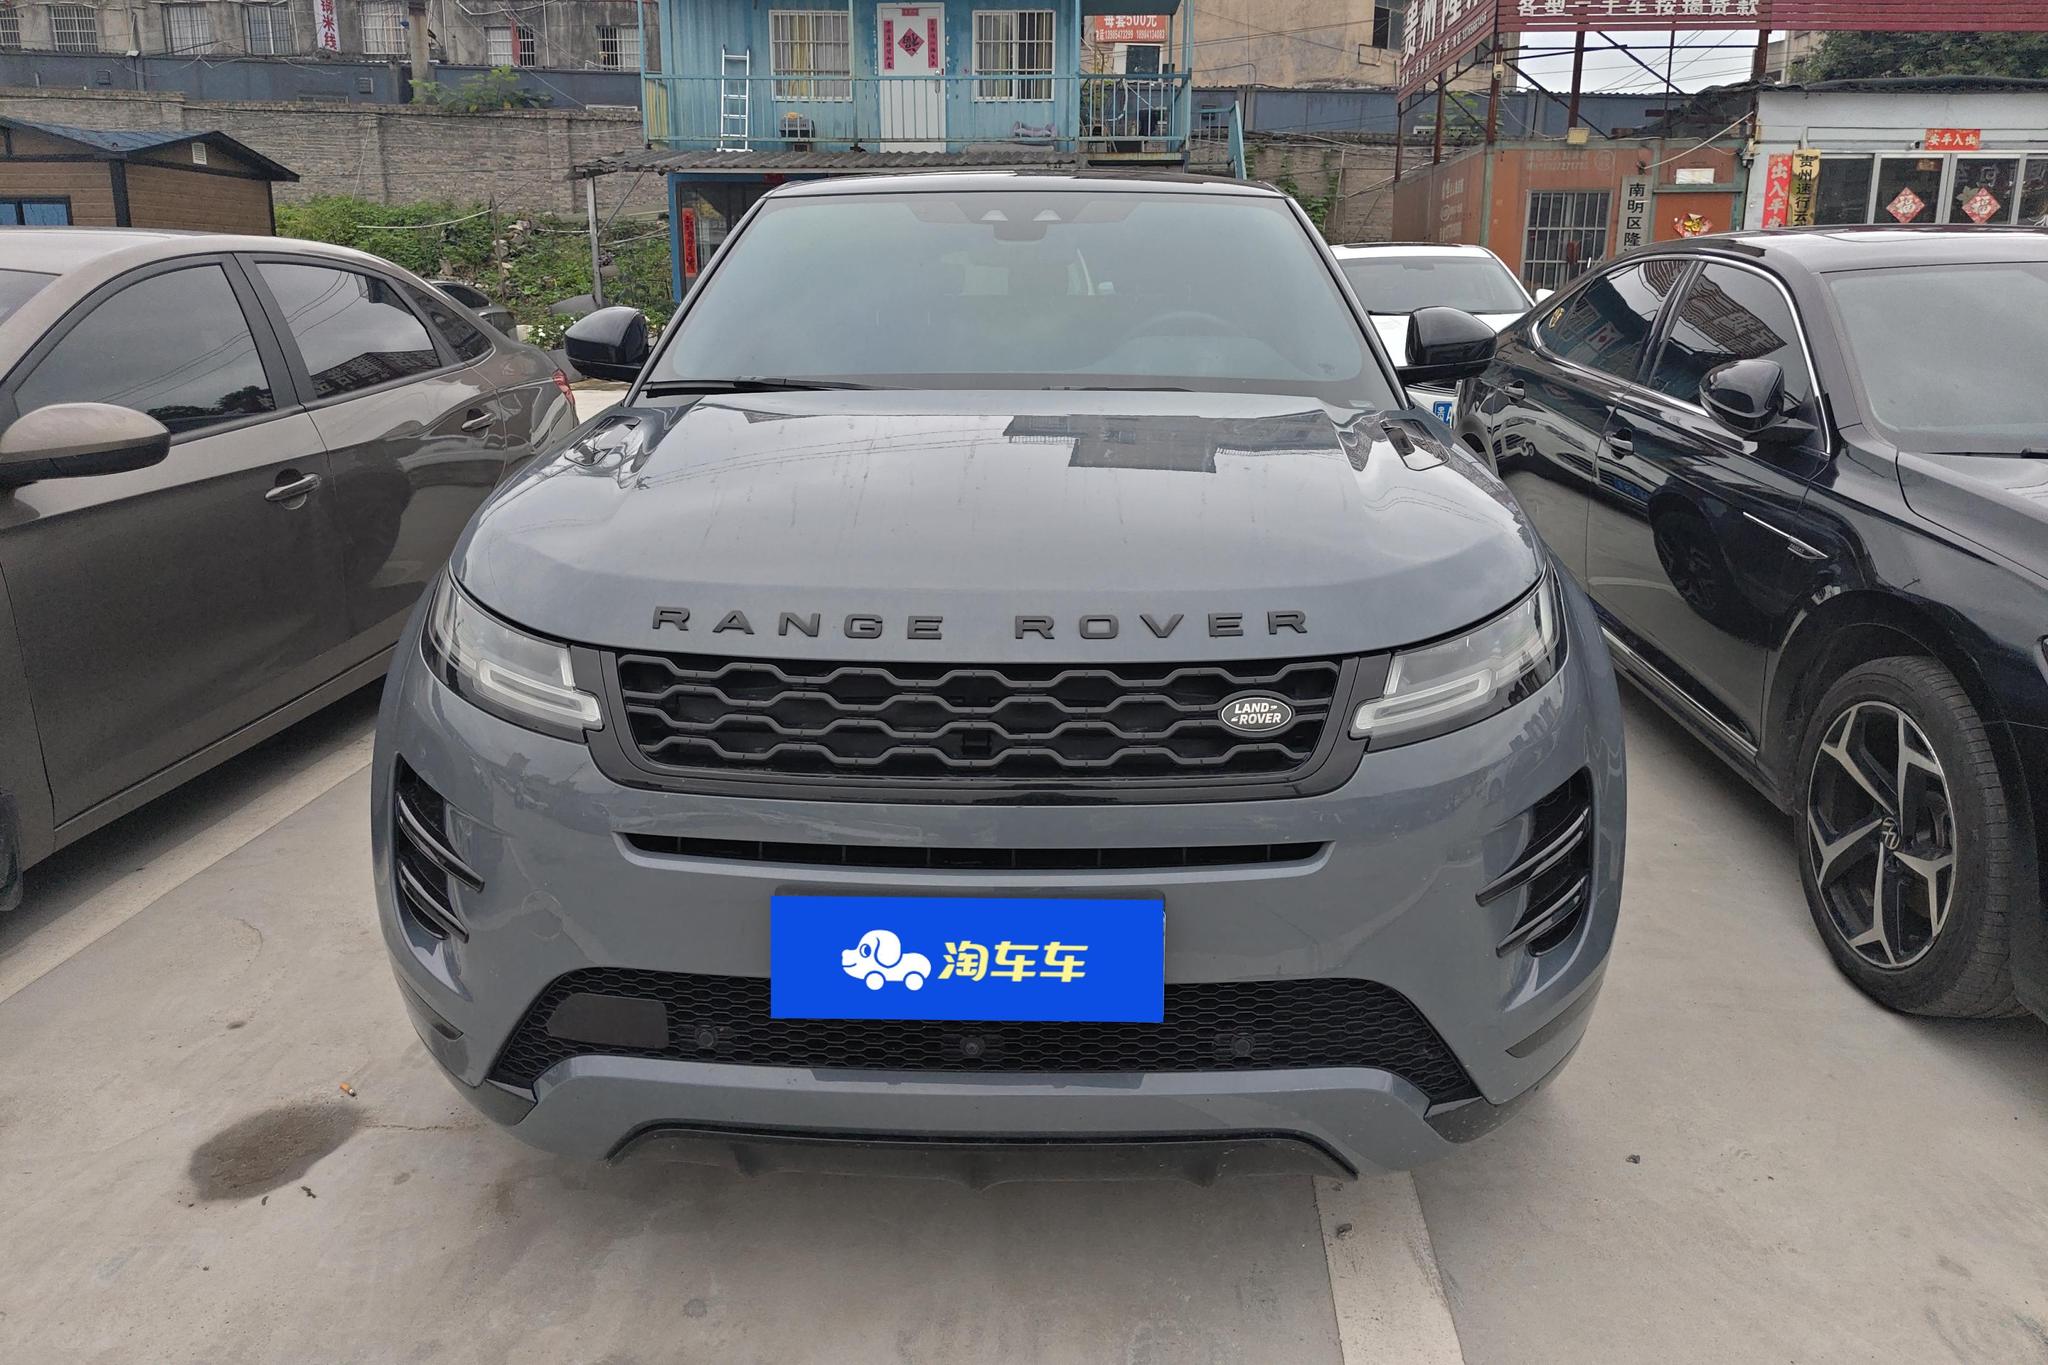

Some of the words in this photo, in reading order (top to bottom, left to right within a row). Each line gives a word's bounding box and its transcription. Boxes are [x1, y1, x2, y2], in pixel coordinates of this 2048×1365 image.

[1623, 183, 1647, 251] 南明区隆
[652, 606, 943, 640] RANGE
[1015, 610, 1307, 640] ROVER
[1234, 702, 1270, 714] LAND
[1239, 712, 1282, 725] ROVER
